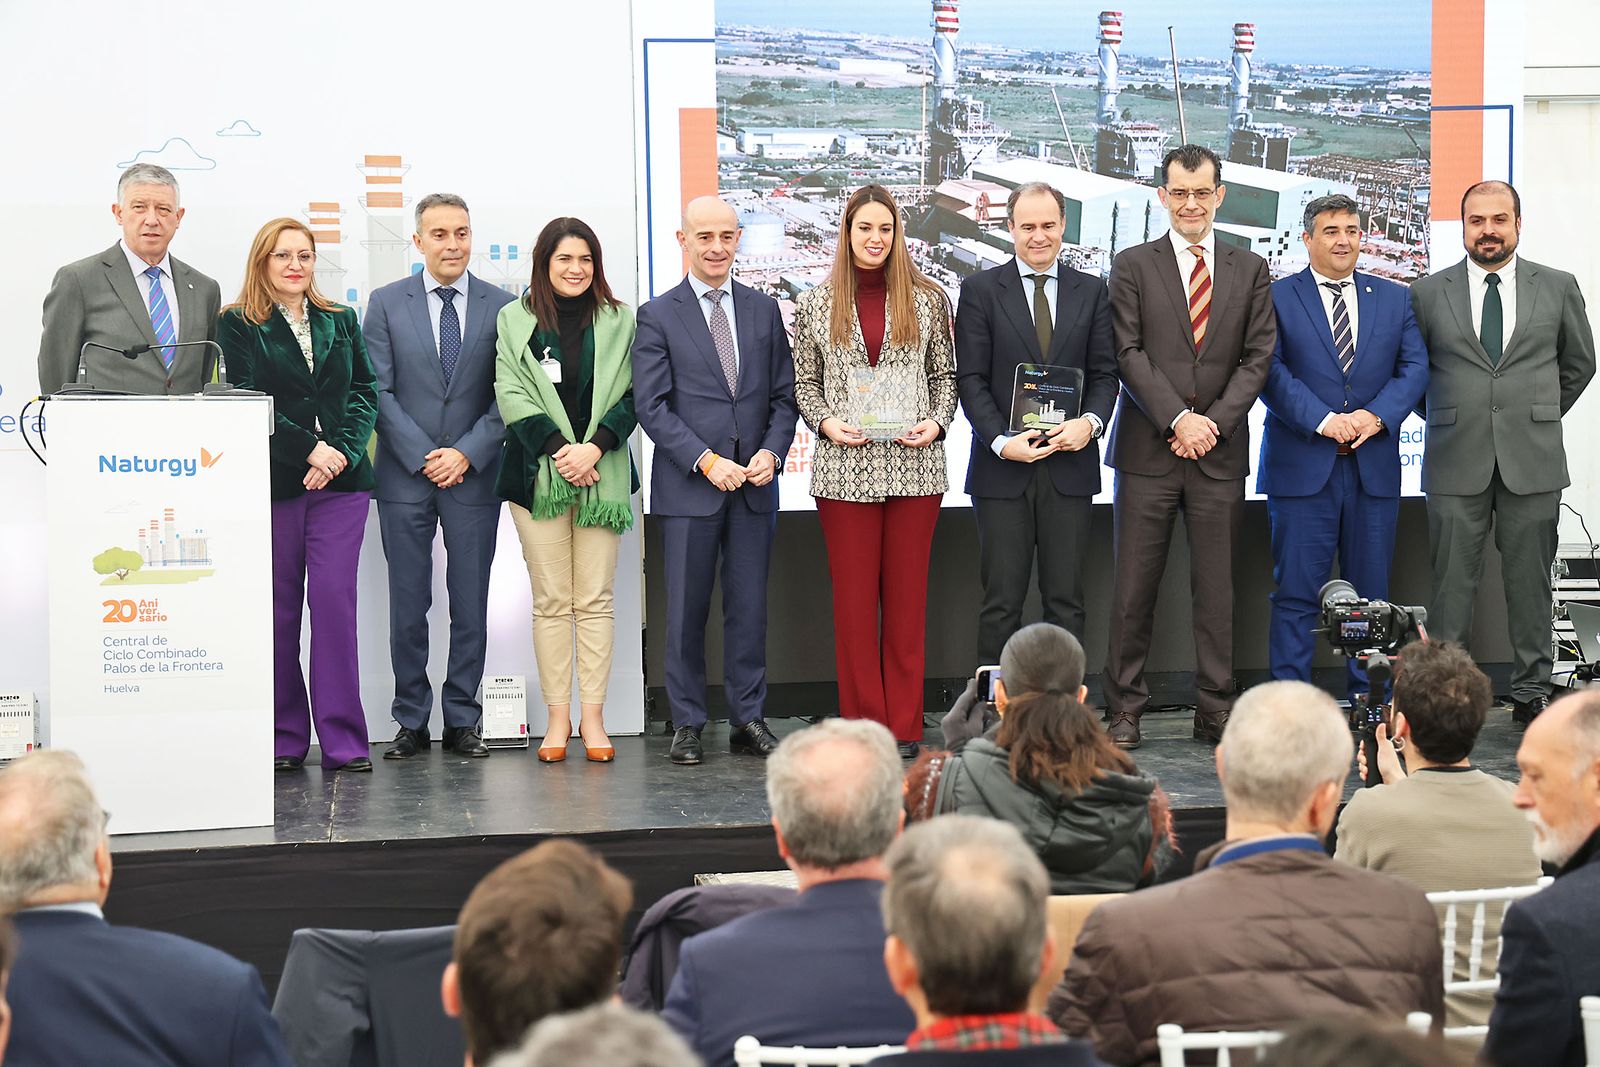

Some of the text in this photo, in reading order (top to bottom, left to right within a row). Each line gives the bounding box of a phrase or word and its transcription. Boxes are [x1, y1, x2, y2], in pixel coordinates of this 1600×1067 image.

[0, 415, 46, 433] era
[796, 428, 809, 444] ni
[1400, 426, 1423, 443] ad
[788, 446, 814, 458] er.
[99, 455, 197, 477] Naturgy
[1400, 454, 1423, 466] on
[139, 598, 158, 608] Ani
[102, 599, 138, 623] 20
[139, 614, 168, 622] sario
[103, 635, 168, 647] Central de
[103, 647, 207, 661] Ciclo Combinado
[103, 660, 224, 674] Palos de la Frontera
[104, 683, 140, 693] Huelva
